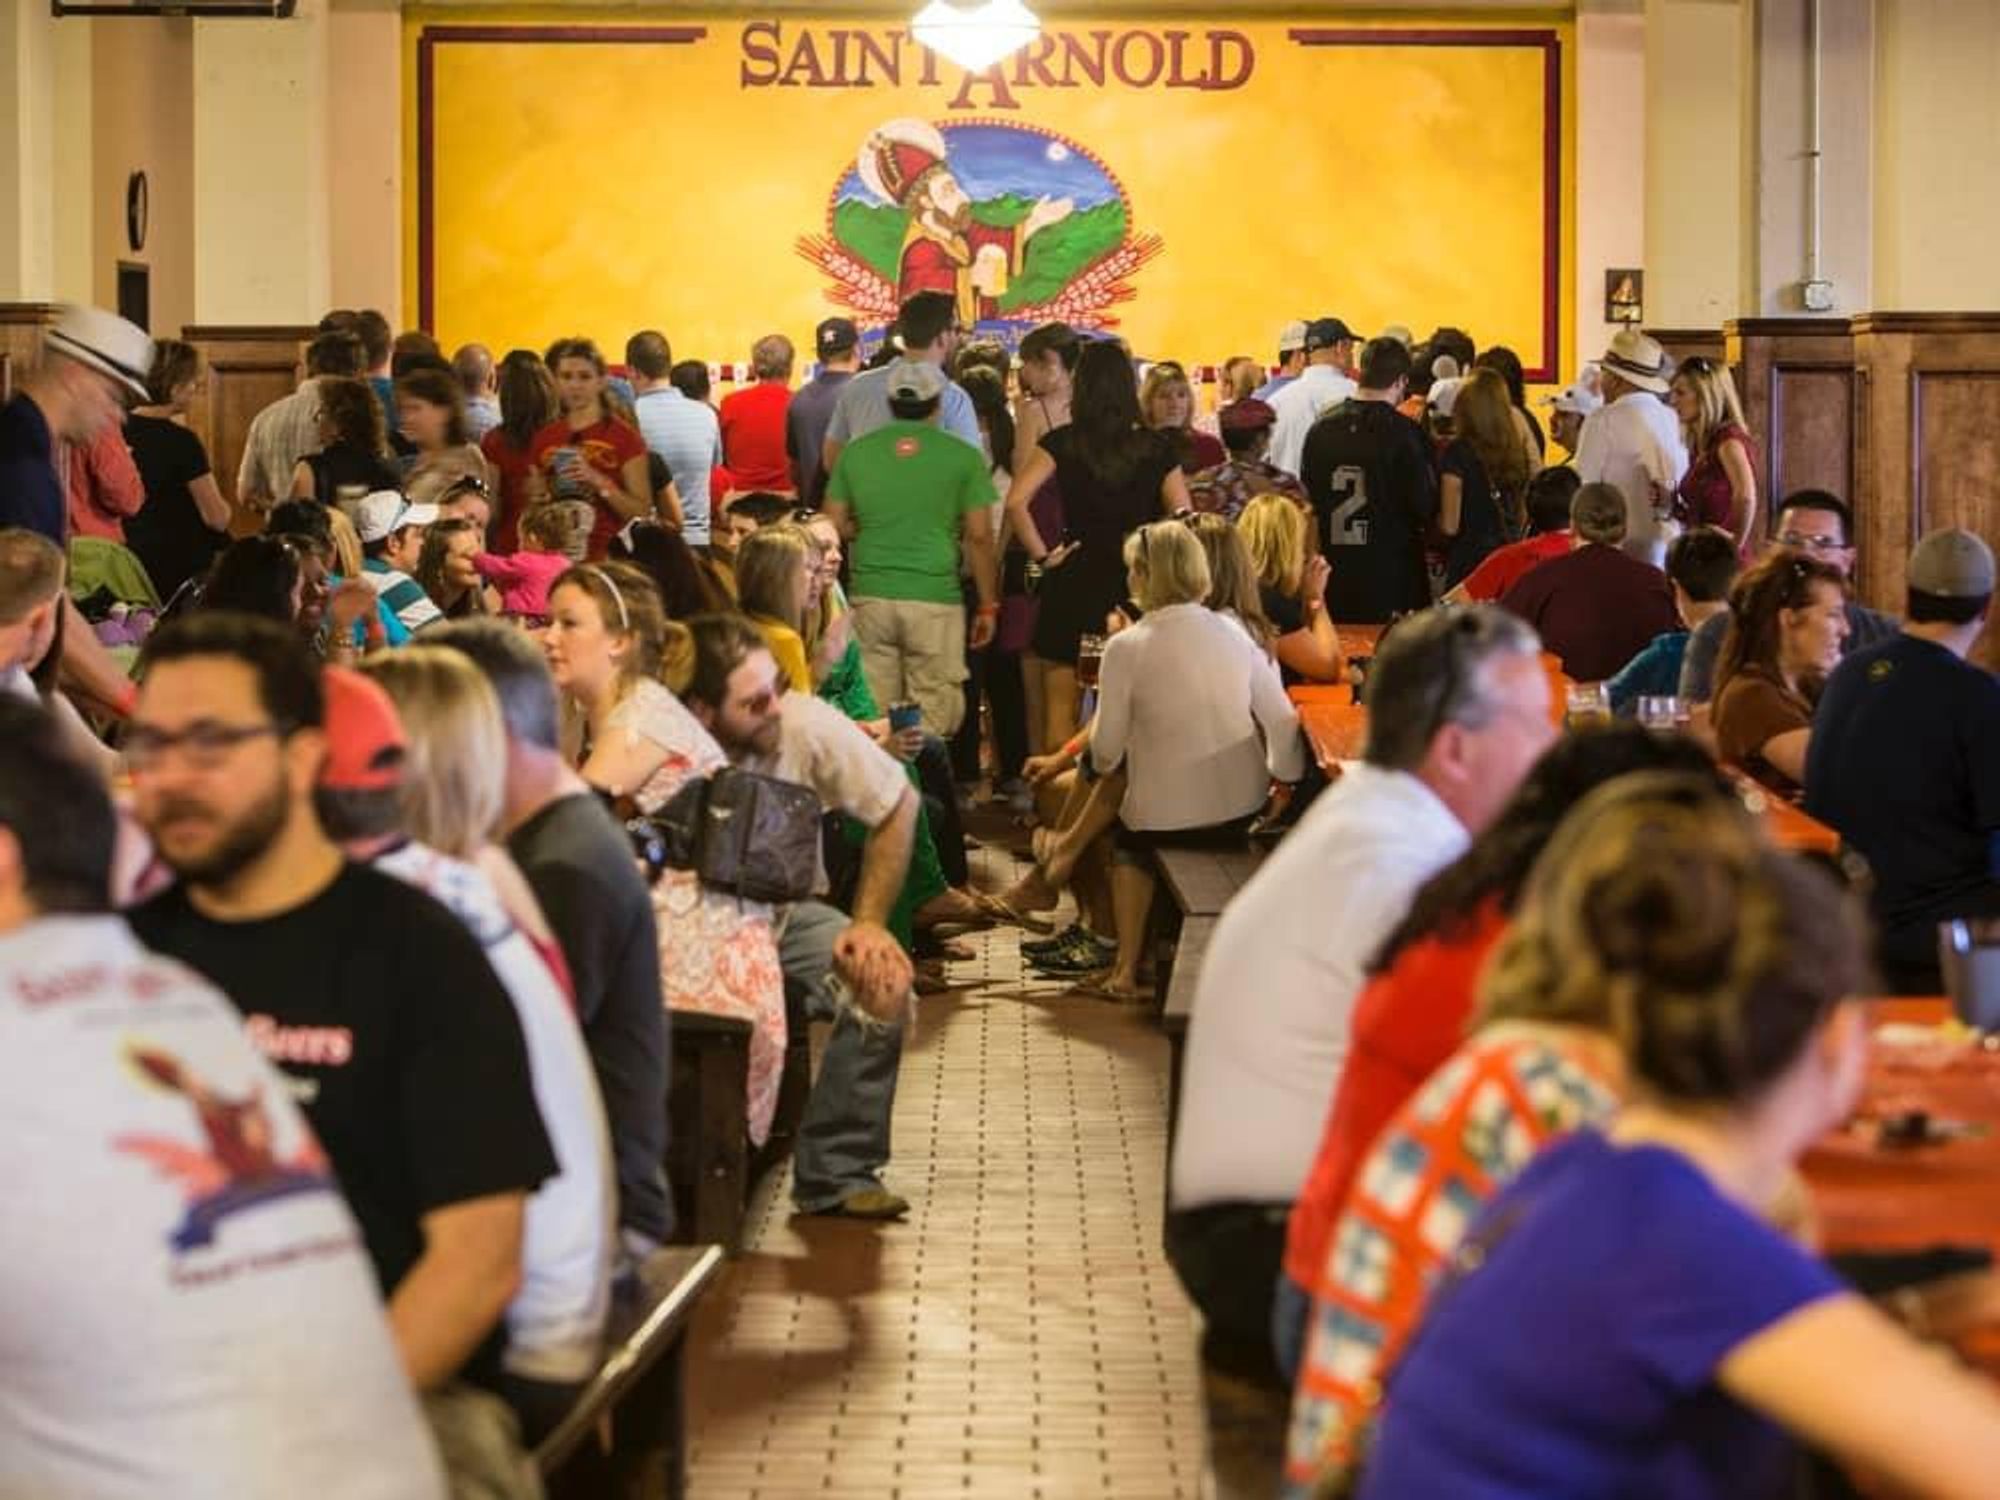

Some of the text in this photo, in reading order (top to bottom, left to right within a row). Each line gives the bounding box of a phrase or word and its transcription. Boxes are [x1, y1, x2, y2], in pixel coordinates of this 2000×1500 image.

[741, 18, 1255, 110] SAINT ARNOLD
[1330, 465, 1368, 545] 2
